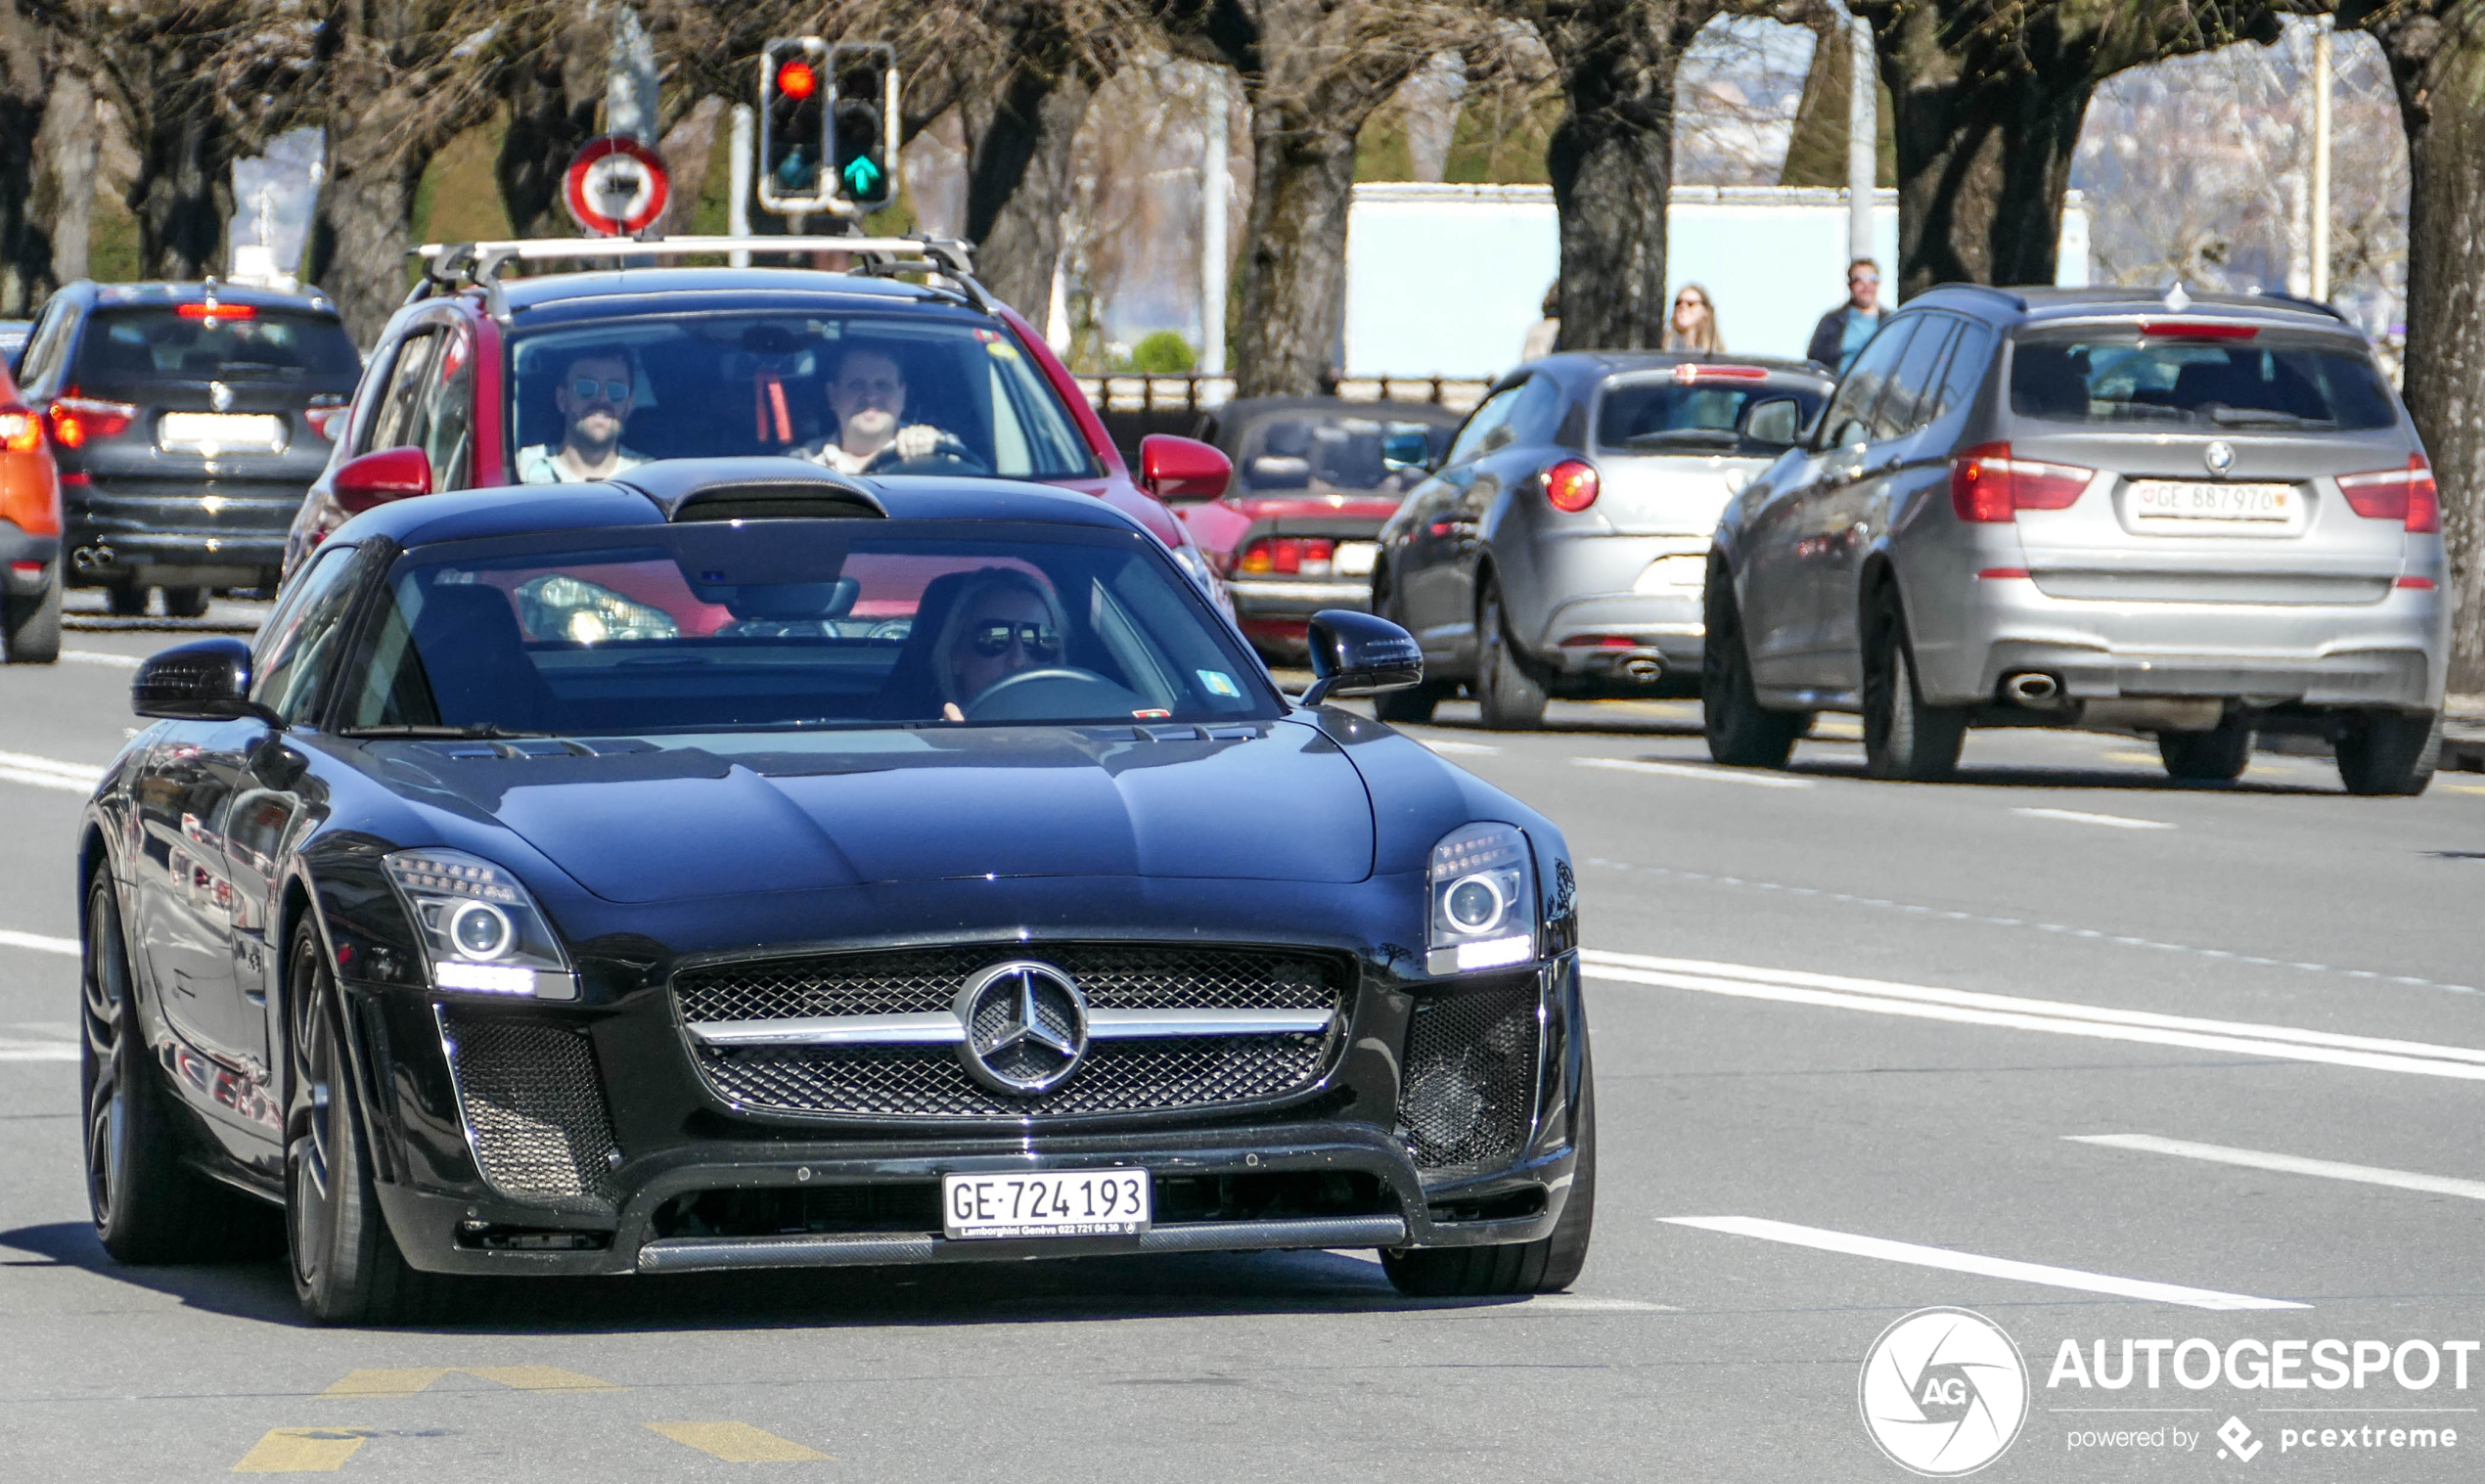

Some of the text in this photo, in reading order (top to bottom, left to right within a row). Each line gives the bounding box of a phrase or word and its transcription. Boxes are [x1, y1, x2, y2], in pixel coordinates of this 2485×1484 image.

[2157, 484, 2183, 508] GE
[1080, 1178, 1141, 1217] 193
[961, 1226, 1020, 1237] Lamborghini
[1058, 1225, 1075, 1235] 022
[1077, 1224, 1092, 1234] 721
[1107, 1223, 1119, 1233] 30
